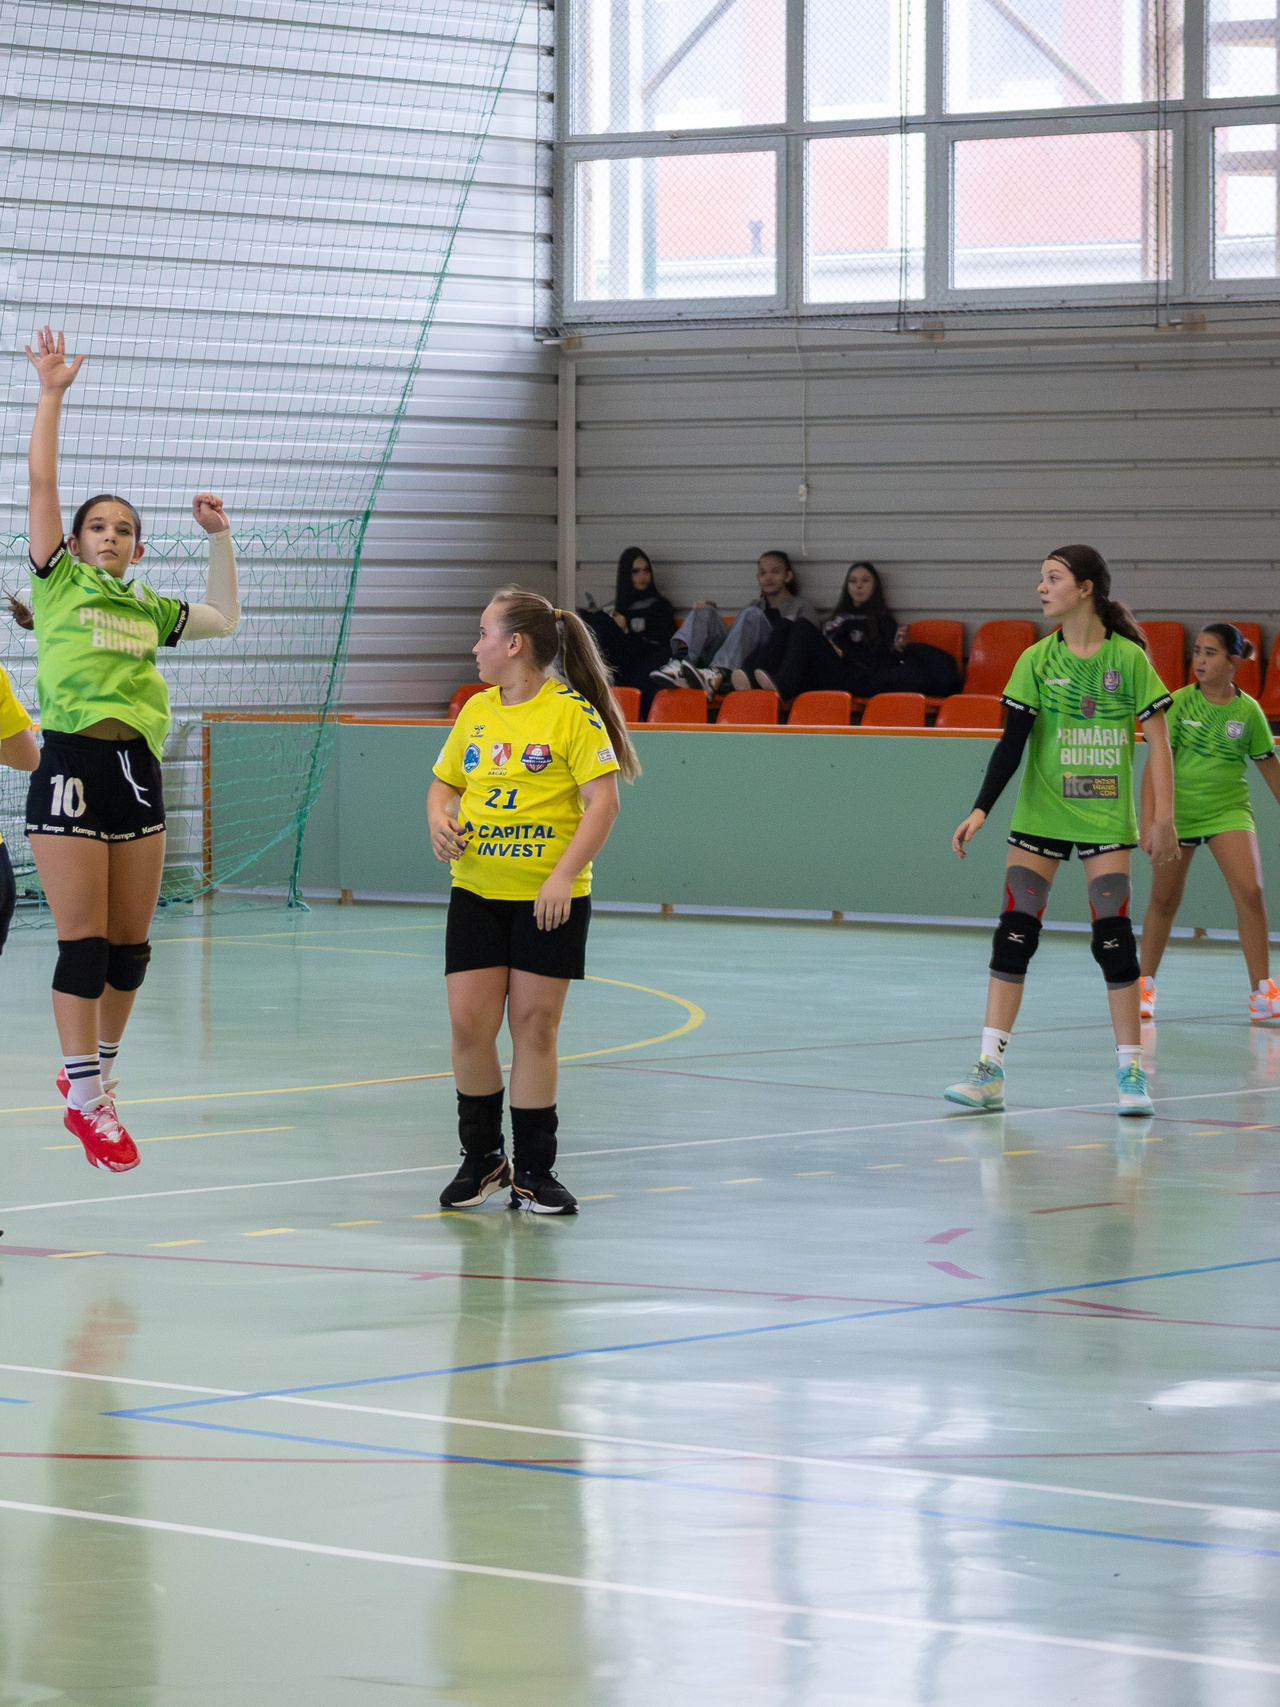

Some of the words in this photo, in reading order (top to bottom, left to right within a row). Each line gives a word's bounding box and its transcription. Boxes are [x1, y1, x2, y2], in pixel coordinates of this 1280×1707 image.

[1060, 747, 1121, 769] BUHUȘI
[50, 774, 86, 818] 10
[484, 788, 519, 810] 21
[42, 823, 65, 834] Kempa
[478, 824, 556, 840] CAPITAL
[477, 842, 547, 858] INVEST
